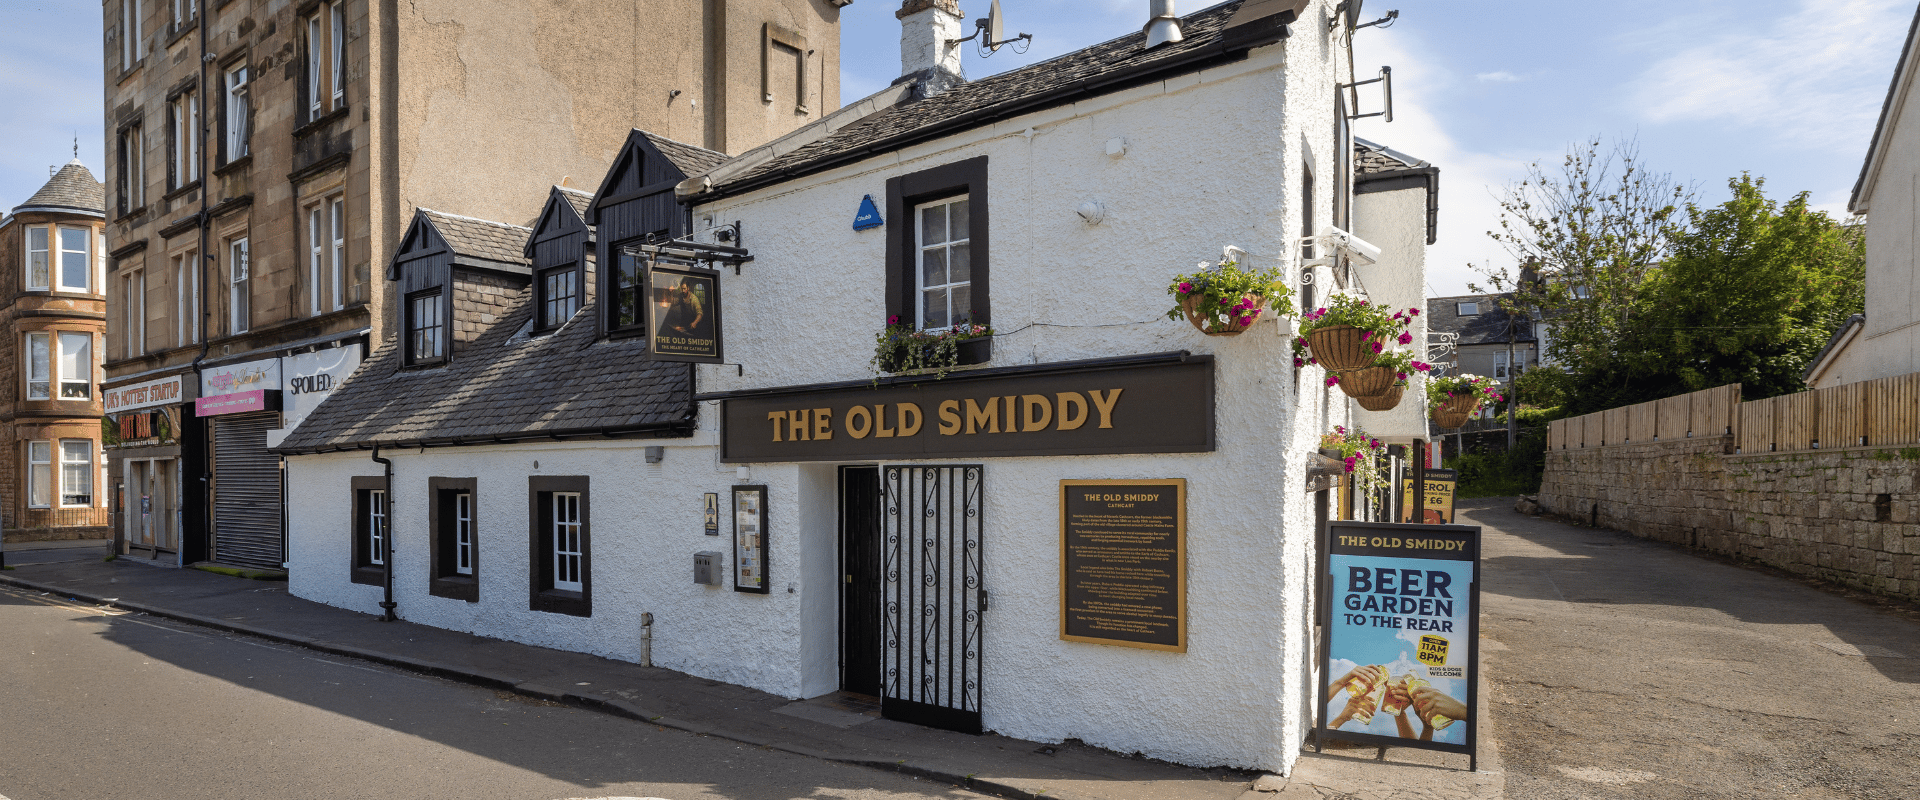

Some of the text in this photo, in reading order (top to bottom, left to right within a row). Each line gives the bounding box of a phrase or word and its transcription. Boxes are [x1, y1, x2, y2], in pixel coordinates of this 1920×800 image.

[121, 386, 148, 406] HOTTEST
[150, 381, 179, 402] STARTUP
[291, 374, 330, 395] SPOILED
[768, 388, 1124, 442] THE OLD SMIDDY
[120, 414, 134, 440] HOT
[1407, 482, 1450, 492] AEROL
[1339, 536, 1466, 551] THE OLD SMIDDY
[1348, 566, 1453, 598] BEER
[1344, 594, 1453, 618] GARDEN
[1344, 613, 1453, 632] TO THE REAR
[1420, 652, 1444, 663] 8PM
[1422, 643, 1446, 653] 11AM
